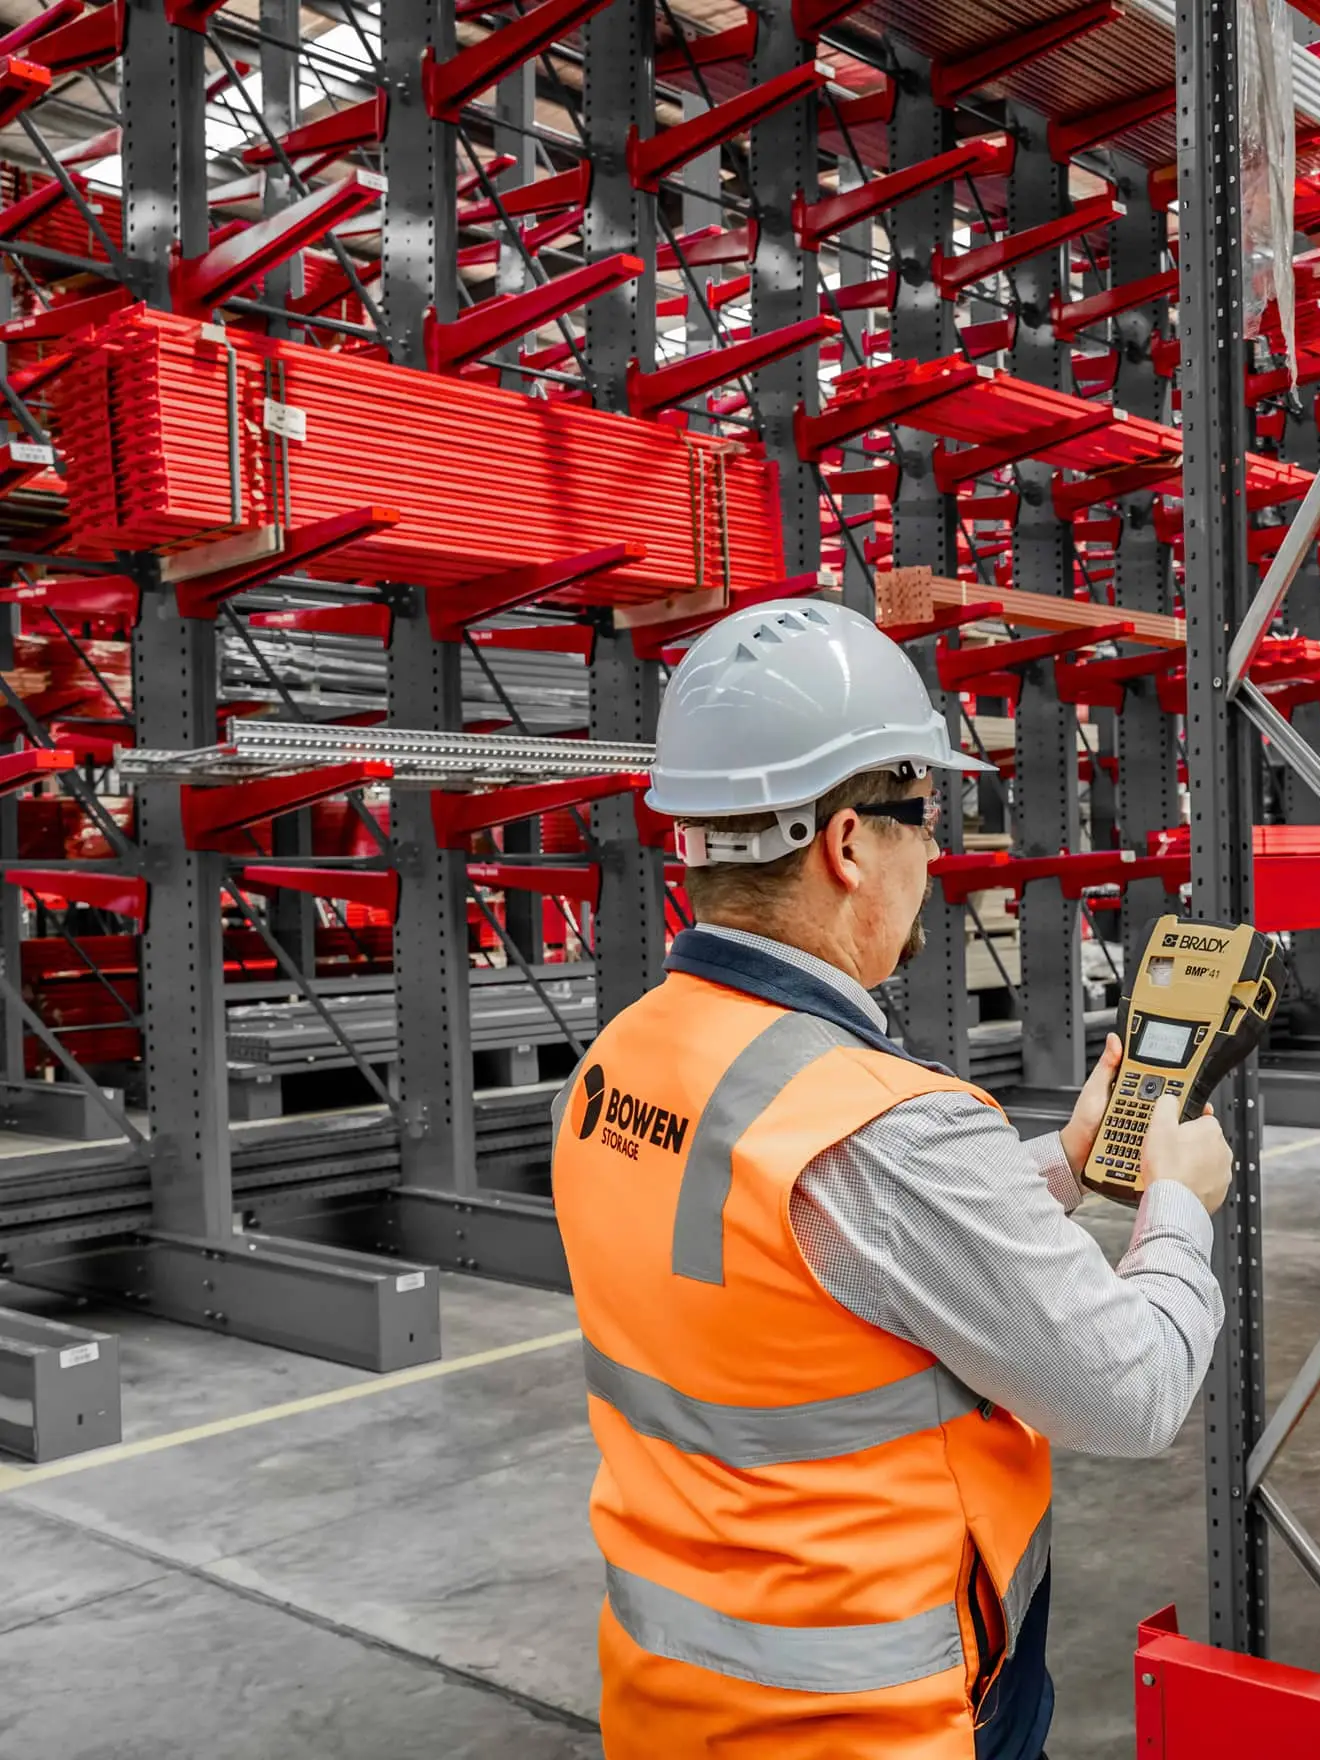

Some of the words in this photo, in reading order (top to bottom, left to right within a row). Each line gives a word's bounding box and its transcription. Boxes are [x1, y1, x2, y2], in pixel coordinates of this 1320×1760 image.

[1179, 935, 1230, 954] BRADY
[605, 1088, 690, 1154] BOWEN
[601, 1127, 640, 1161] STORAGE
